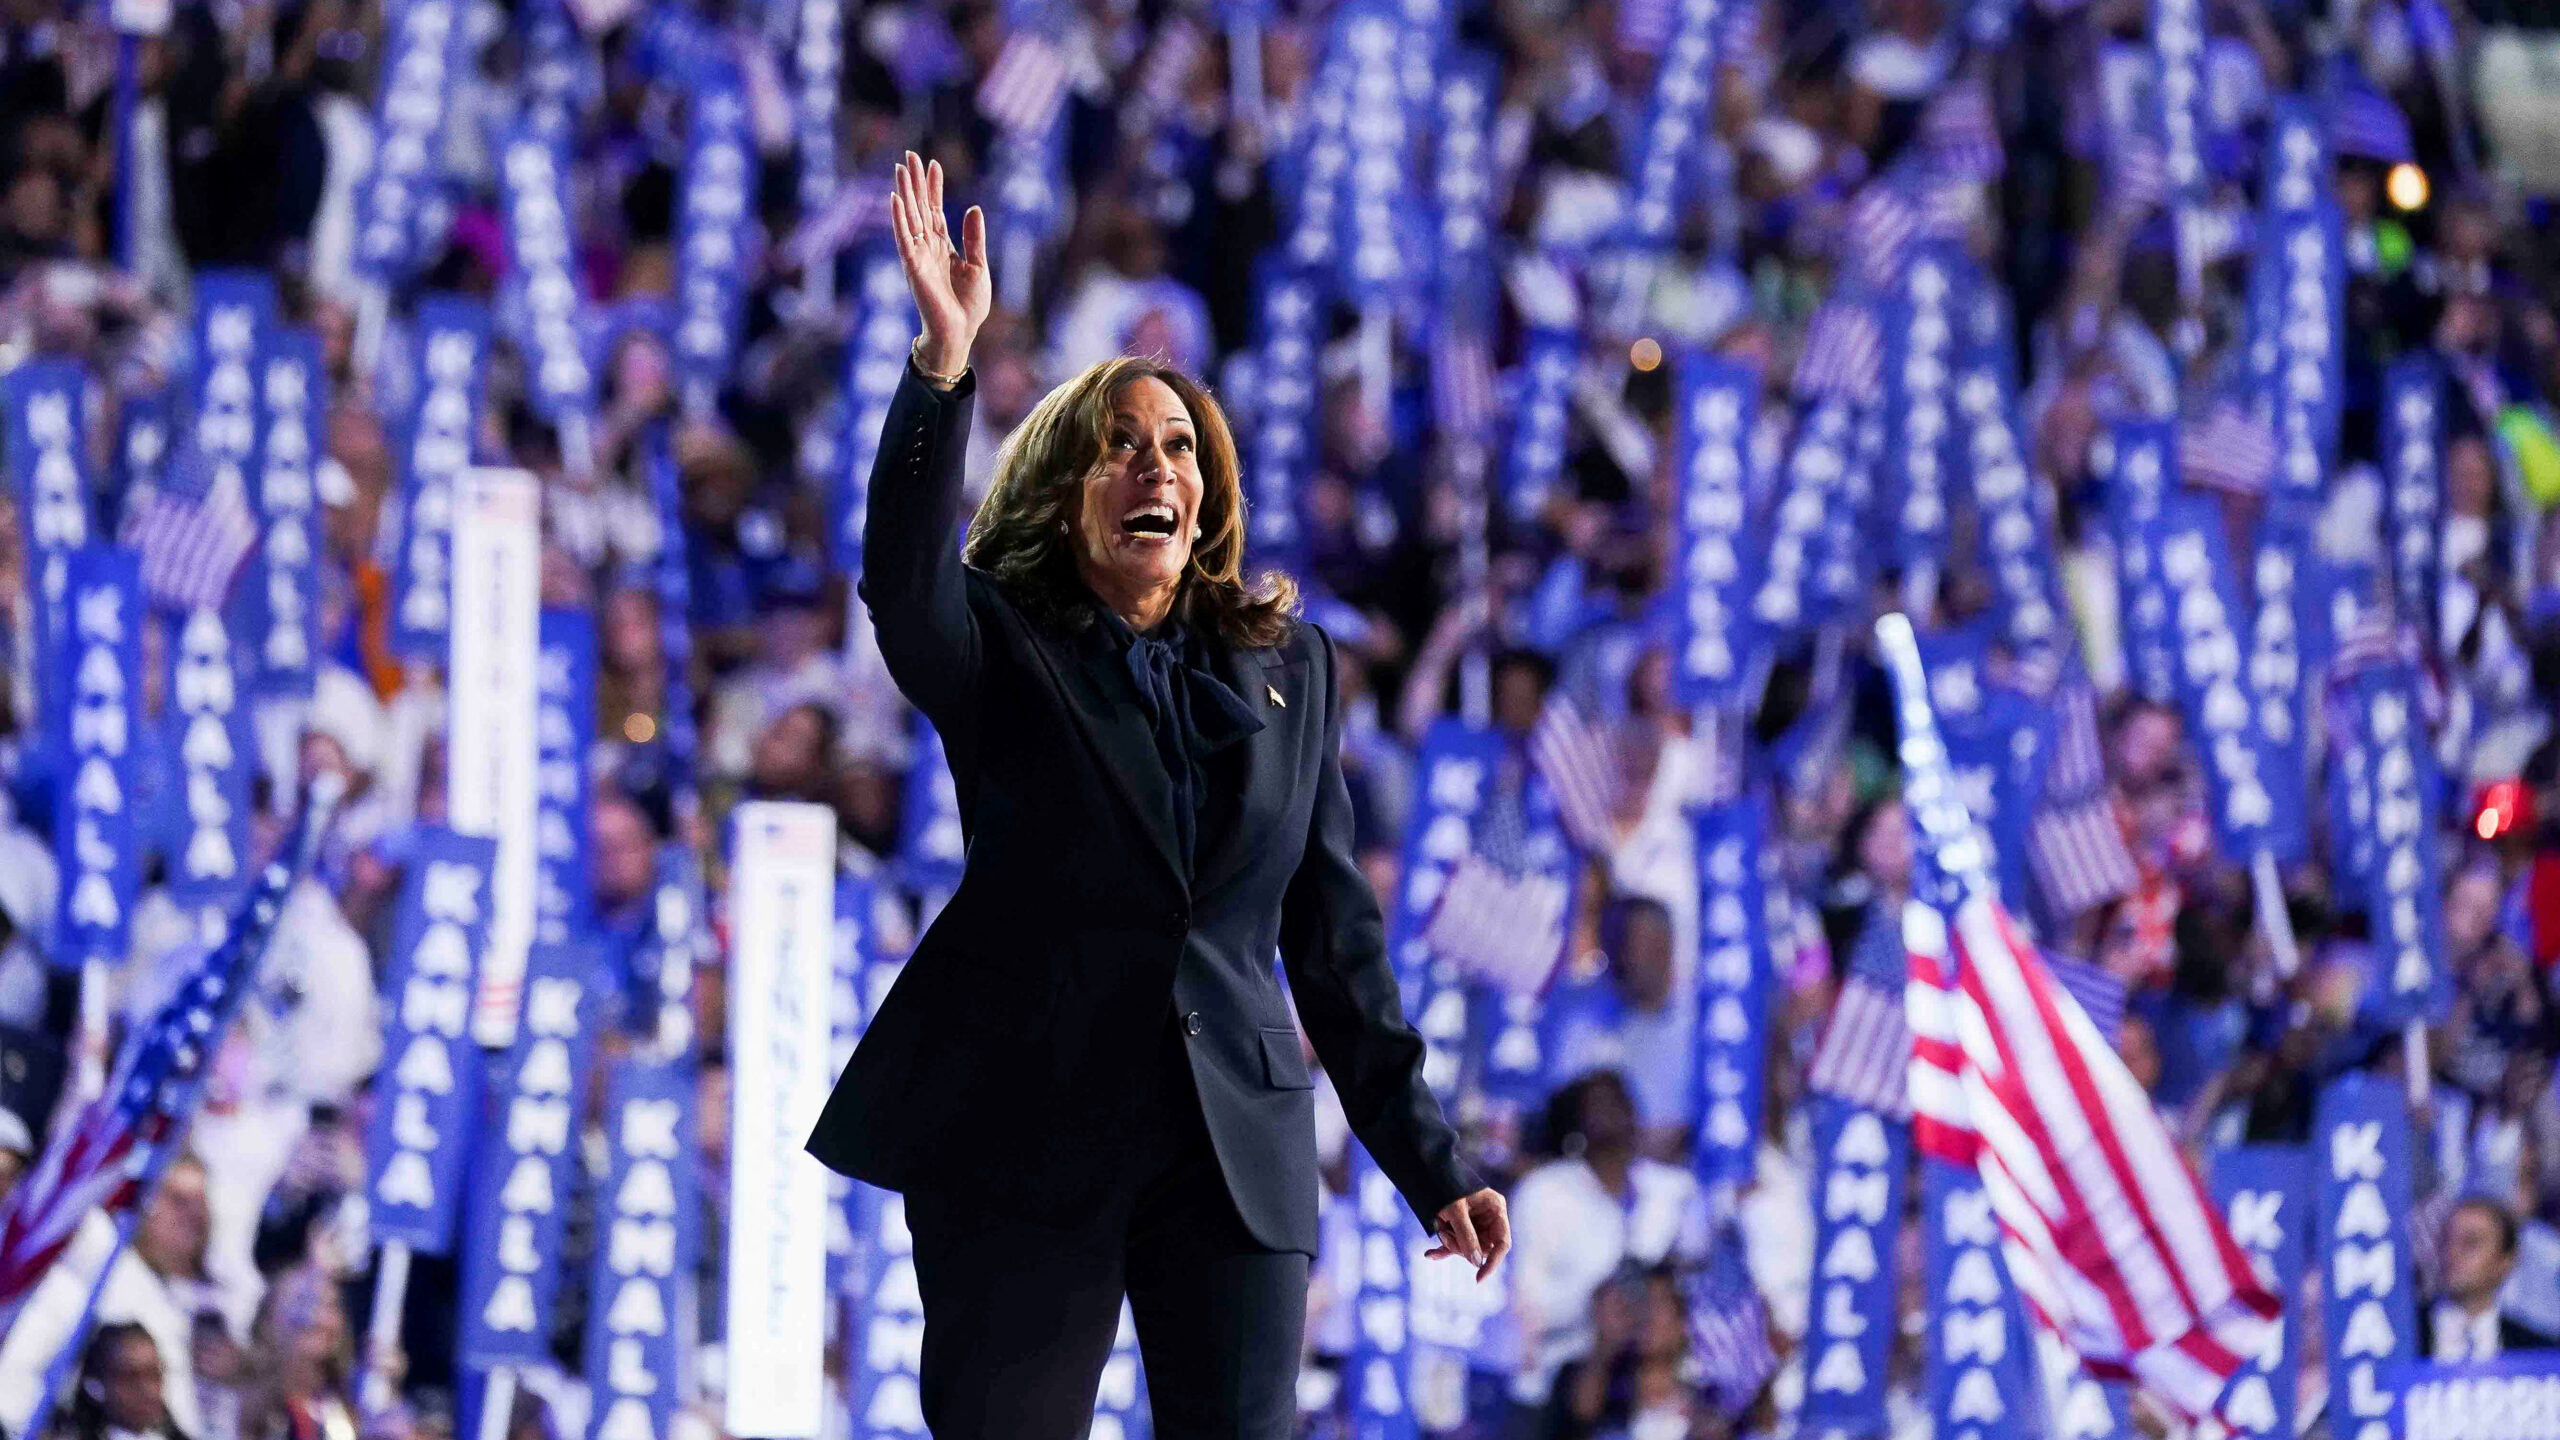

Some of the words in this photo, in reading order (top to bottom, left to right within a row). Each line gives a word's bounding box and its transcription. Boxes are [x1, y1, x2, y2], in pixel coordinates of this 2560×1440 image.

[261, 358, 314, 668] KAMALA
[1686, 390, 1743, 680] KAMALA
[71, 583, 128, 929] KAMALA
[176, 608, 236, 882] AMALA
[2163, 533, 2272, 829] KAMALA
[2371, 691, 2432, 990] KAMALA
[377, 861, 483, 1209] KAMALA
[1705, 838, 1751, 1149] KAMALA
[484, 976, 582, 1332] KAMALA
[600, 1098, 681, 1440] KAMALA
[1813, 1112, 1889, 1395] AMALA
[1943, 1187, 2006, 1440] KAMA
